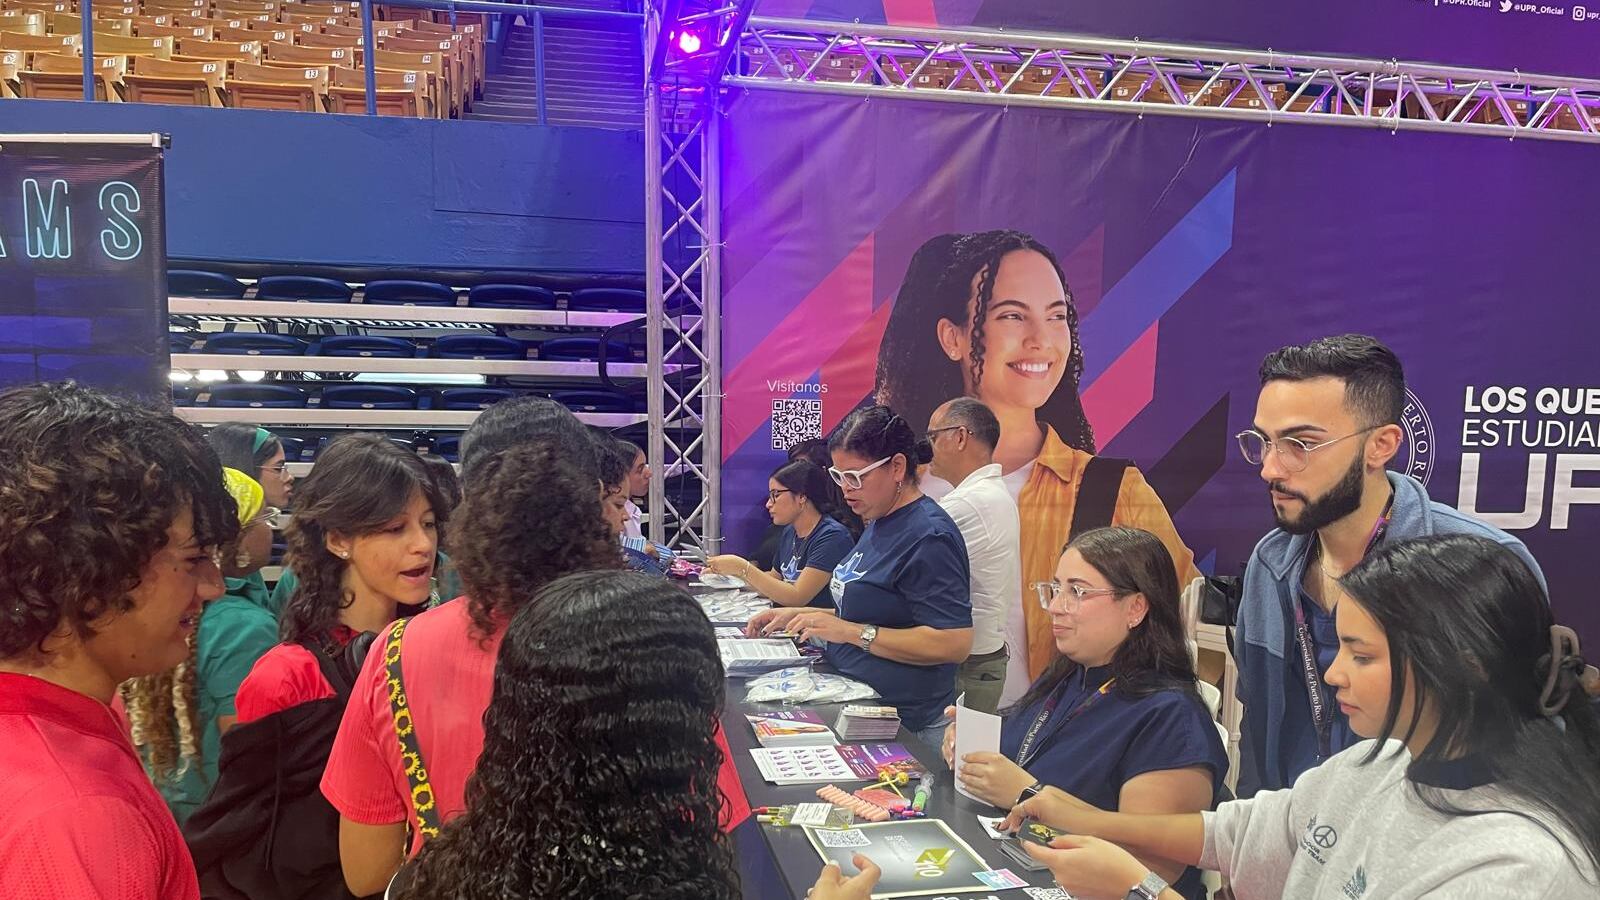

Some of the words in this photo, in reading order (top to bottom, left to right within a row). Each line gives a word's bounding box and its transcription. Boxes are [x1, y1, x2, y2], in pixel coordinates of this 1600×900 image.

[1514, 3, 1564, 15] @UPR_Oficial
[1586, 11, 1600, 20] upr
[0, 178, 142, 260] MS
[1464, 386, 1527, 414] LOS
[1535, 387, 1600, 415] QUE
[1403, 402, 1429, 454] ERTO
[1461, 419, 1600, 447] ESTUDIA
[1299, 627, 1314, 672] Universidad
[1307, 671, 1315, 682] de
[1310, 680, 1321, 707] Puerto
[1314, 703, 1322, 721] Rico
